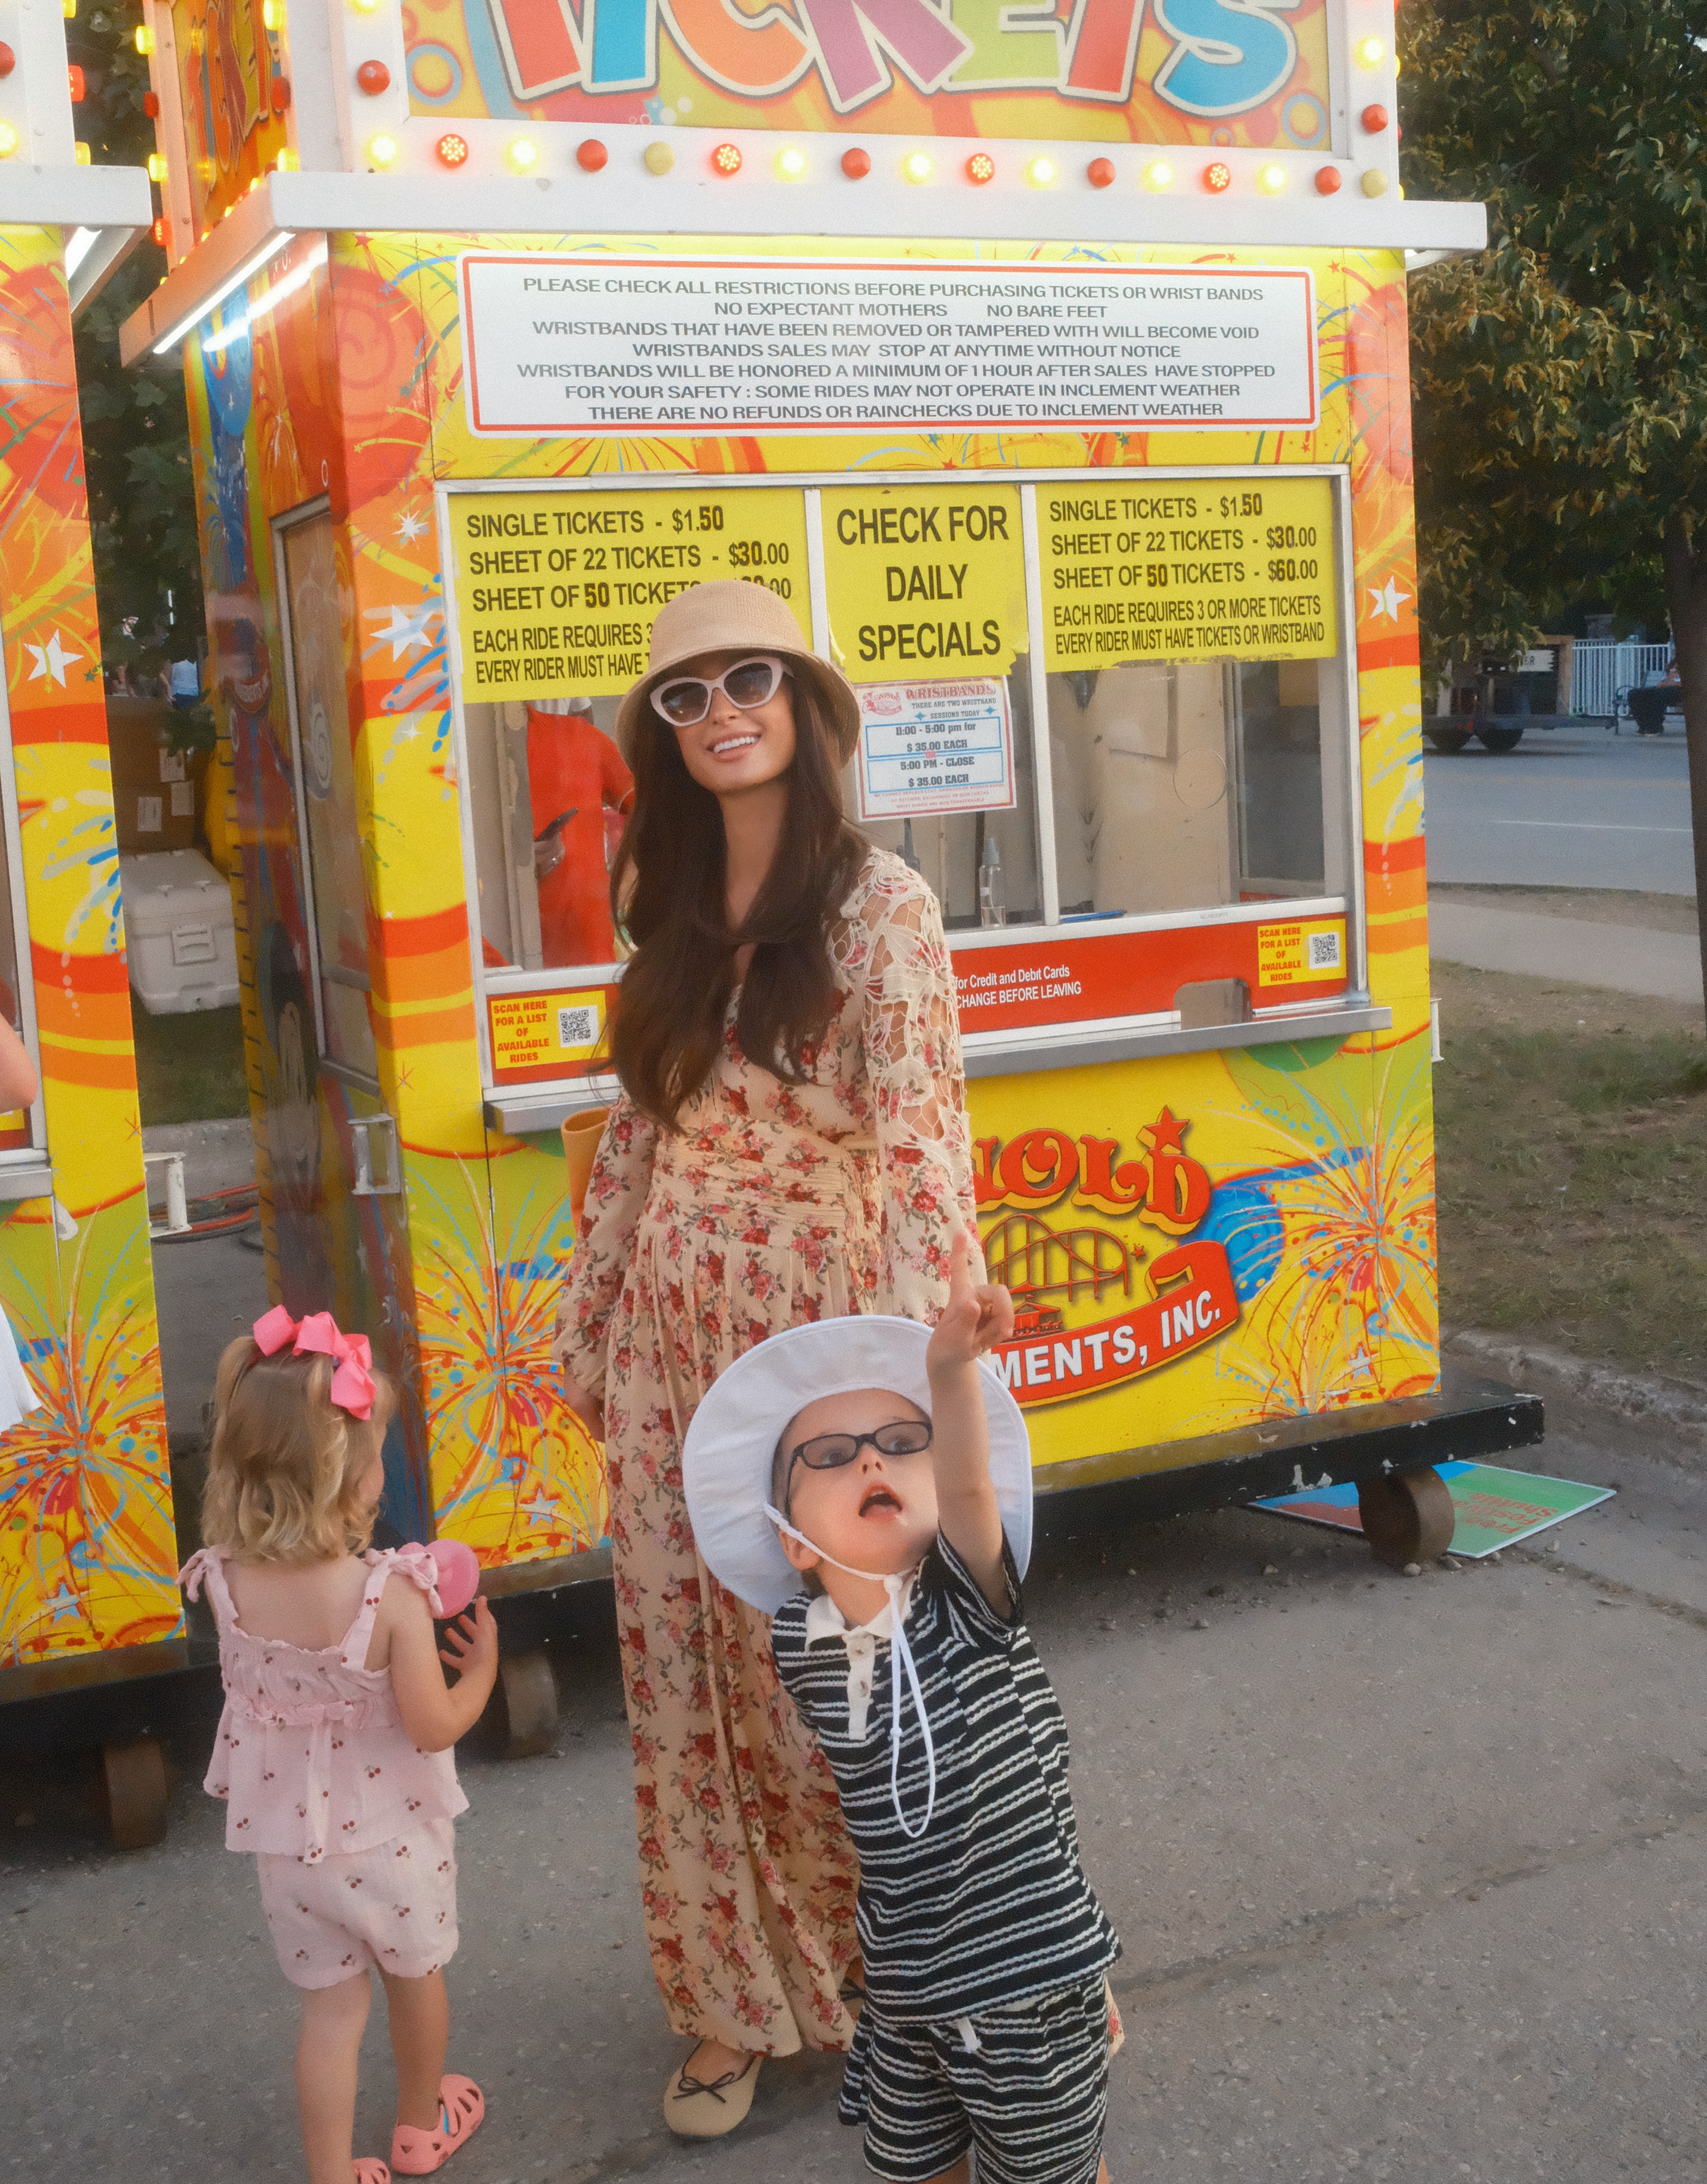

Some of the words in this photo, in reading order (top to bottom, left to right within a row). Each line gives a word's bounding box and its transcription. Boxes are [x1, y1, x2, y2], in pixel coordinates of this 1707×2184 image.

[524, 278, 601, 292] PLEASE
[605, 279, 672, 293] CHECK
[675, 280, 711, 294] ALL
[715, 281, 850, 295] RESTRICTIONS
[855, 283, 925, 296] BEFORE
[930, 284, 1046, 298] PURCHASING
[1049, 285, 1119, 299] TICKETS
[1122, 286, 1146, 299] OR
[1149, 287, 1203, 300] WRIST
[1207, 288, 1263, 301] BANDS
[714, 302, 743, 315] NO
[747, 302, 854, 316] EXPECTANT
[859, 303, 948, 317] MOTHERS
[987, 304, 1013, 317] NO
[1017, 305, 1063, 317] BARE
[1067, 306, 1107, 318] FEET
[533, 321, 668, 336] WRISTBANDS
[671, 323, 720, 336] THAT
[724, 323, 775, 336] HAVE
[779, 323, 827, 336] BEEN
[833, 324, 923, 336] REMOVED
[927, 324, 952, 336] OR
[955, 324, 1050, 337] TAMPERED
[1053, 325, 1099, 338] WITH
[1102, 326, 1145, 338] WILL
[1148, 326, 1217, 339] BECOME
[1220, 327, 1259, 339] VOID
[632, 343, 764, 357] WRISTBANDS
[767, 344, 827, 357] SALES
[832, 344, 871, 357] MAY
[879, 344, 926, 357] STOP
[929, 344, 951, 357] AT
[954, 344, 1034, 357] ANYTIME
[1037, 345, 1117, 357] WITHOUT
[1121, 345, 1181, 358] NOTICE
[565, 386, 605, 399] FOR
[608, 386, 664, 399] YOUR
[668, 386, 742, 399] SAFETY
[755, 385, 810, 398] SOME
[815, 385, 869, 398] RIDES
[874, 385, 912, 397] MAY
[916, 384, 953, 397] NOT
[956, 384, 1035, 397] OPERATE
[1038, 384, 1056, 396] IN
[1060, 384, 1157, 397] INCLEMENT
[1160, 384, 1240, 396] WEATHER
[1050, 499, 1117, 522] SINGLE
[1121, 497, 1197, 519] TICKETS
[1220, 493, 1262, 518] $1.50
[467, 512, 548, 538] SINGLE
[552, 510, 644, 535] TICKETS
[672, 505, 724, 534] $1.50
[837, 507, 942, 545] CHECK
[948, 505, 1009, 541] FOR
[1052, 533, 1112, 556] SHEET
[1116, 532, 1141, 553] OF
[1146, 531, 1165, 552] 22
[1169, 528, 1244, 551] TICKETS
[1266, 525, 1317, 550] $30.00
[470, 550, 542, 575] SHEET
[548, 548, 577, 572] OF
[583, 548, 607, 571] 22
[611, 544, 701, 569] TICKETS
[728, 540, 789, 568] $30.00
[886, 564, 968, 602] DAILY
[1053, 566, 1114, 590] SHEET
[1118, 565, 1142, 587] OF
[1147, 564, 1168, 588] 50
[1171, 561, 1245, 584] TICKETS
[1268, 558, 1318, 582] $60.00
[472, 586, 545, 612] SHEET
[550, 585, 579, 608] OF
[584, 582, 610, 608] 50
[1053, 605, 1091, 627] EACH
[1094, 603, 1125, 624] RIDE
[1128, 600, 1195, 623] REQUIRES
[1197, 599, 1205, 621] 3
[1207, 599, 1227, 620] OR
[1229, 597, 1267, 619] MORE
[1269, 595, 1321, 616] TICKETS
[473, 629, 518, 653] EACH
[522, 627, 560, 651] RIDE
[562, 623, 643, 648] REQUIRES
[858, 620, 1001, 662] SPECIALS
[1056, 632, 1093, 655] EVERY
[1095, 630, 1130, 652] RIDER
[1131, 629, 1162, 651] MUST
[1165, 627, 1194, 648] HAVE
[1196, 625, 1242, 647] TICKETS
[1243, 624, 1260, 645] OR
[1261, 621, 1325, 644] WRISTBAND
[476, 659, 520, 684] EVERY
[524, 656, 565, 680] RIDER
[567, 654, 605, 678] MUST
[607, 653, 643, 676] HAVE
[906, 683, 996, 701] WRISTBANDS
[961, 697, 996, 706] WRISTBAND
[930, 711, 960, 719] SESSIONS
[896, 725, 917, 736] 11:00
[925, 723, 946, 734] 5:00
[948, 725, 962, 734] pm
[964, 722, 976, 731] for
[906, 743, 913, 753] $
[915, 741, 941, 752] 35.00
[943, 739, 968, 750] EACH
[900, 760, 921, 770] 5:00
[923, 759, 938, 769] PM
[945, 756, 975, 767] CLOSE
[908, 777, 915, 788] $
[916, 776, 943, 787] 35.00
[945, 773, 969, 784] EACH
[1259, 928, 1280, 938] SCAN
[1282, 927, 1301, 936] HERE
[1260, 940, 1275, 949] FOR
[1284, 938, 1301, 947] LIST
[1276, 950, 1286, 959] OF
[1261, 960, 1301, 971] AVAILABLE
[954, 976, 968, 990] for
[970, 973, 997, 988] Credit
[999, 970, 1016, 985] and
[1018, 967, 1042, 983] Debit
[1043, 964, 1070, 979] Cards
[1270, 972, 1293, 982] RIDES
[956, 991, 997, 1009] CHANGE
[999, 986, 1038, 1004] BEFORE
[1041, 981, 1082, 999] LEAVING
[493, 1003, 520, 1014] SCAN
[523, 1000, 547, 1011] HERE
[495, 1016, 514, 1027] FOR
[517, 1015, 524, 1024] A
[526, 1013, 547, 1024] LIST
[516, 1027, 528, 1037] OF
[497, 1038, 550, 1052] AVAILABLE
[509, 1051, 539, 1064] RIDES
[1161, 1290, 1221, 1348] INC.
[1451, 1499, 1541, 1526] Festiva
